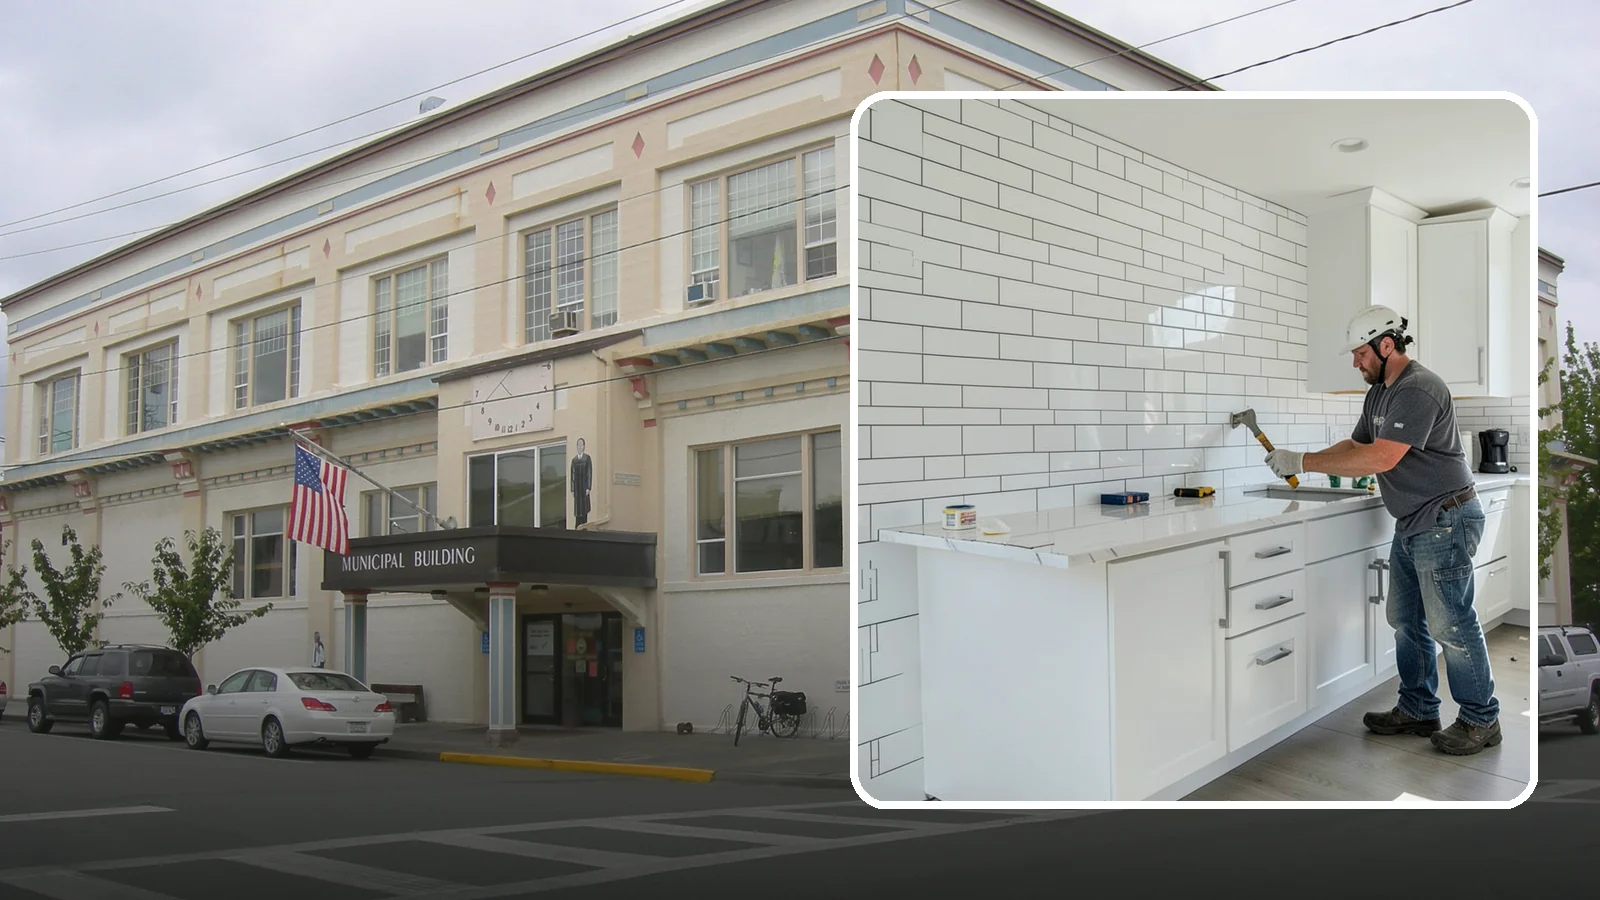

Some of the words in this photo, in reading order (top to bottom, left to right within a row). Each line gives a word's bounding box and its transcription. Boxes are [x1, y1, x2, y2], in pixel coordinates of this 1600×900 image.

[487, 417, 492, 426] 9
[494, 424, 500, 432] 10
[507, 425, 513, 433] 12
[521, 420, 525, 428] 2
[529, 414, 533, 422] 3
[342, 552, 405, 572] MUNICIPAL
[414, 546, 475, 567] BUILDING
